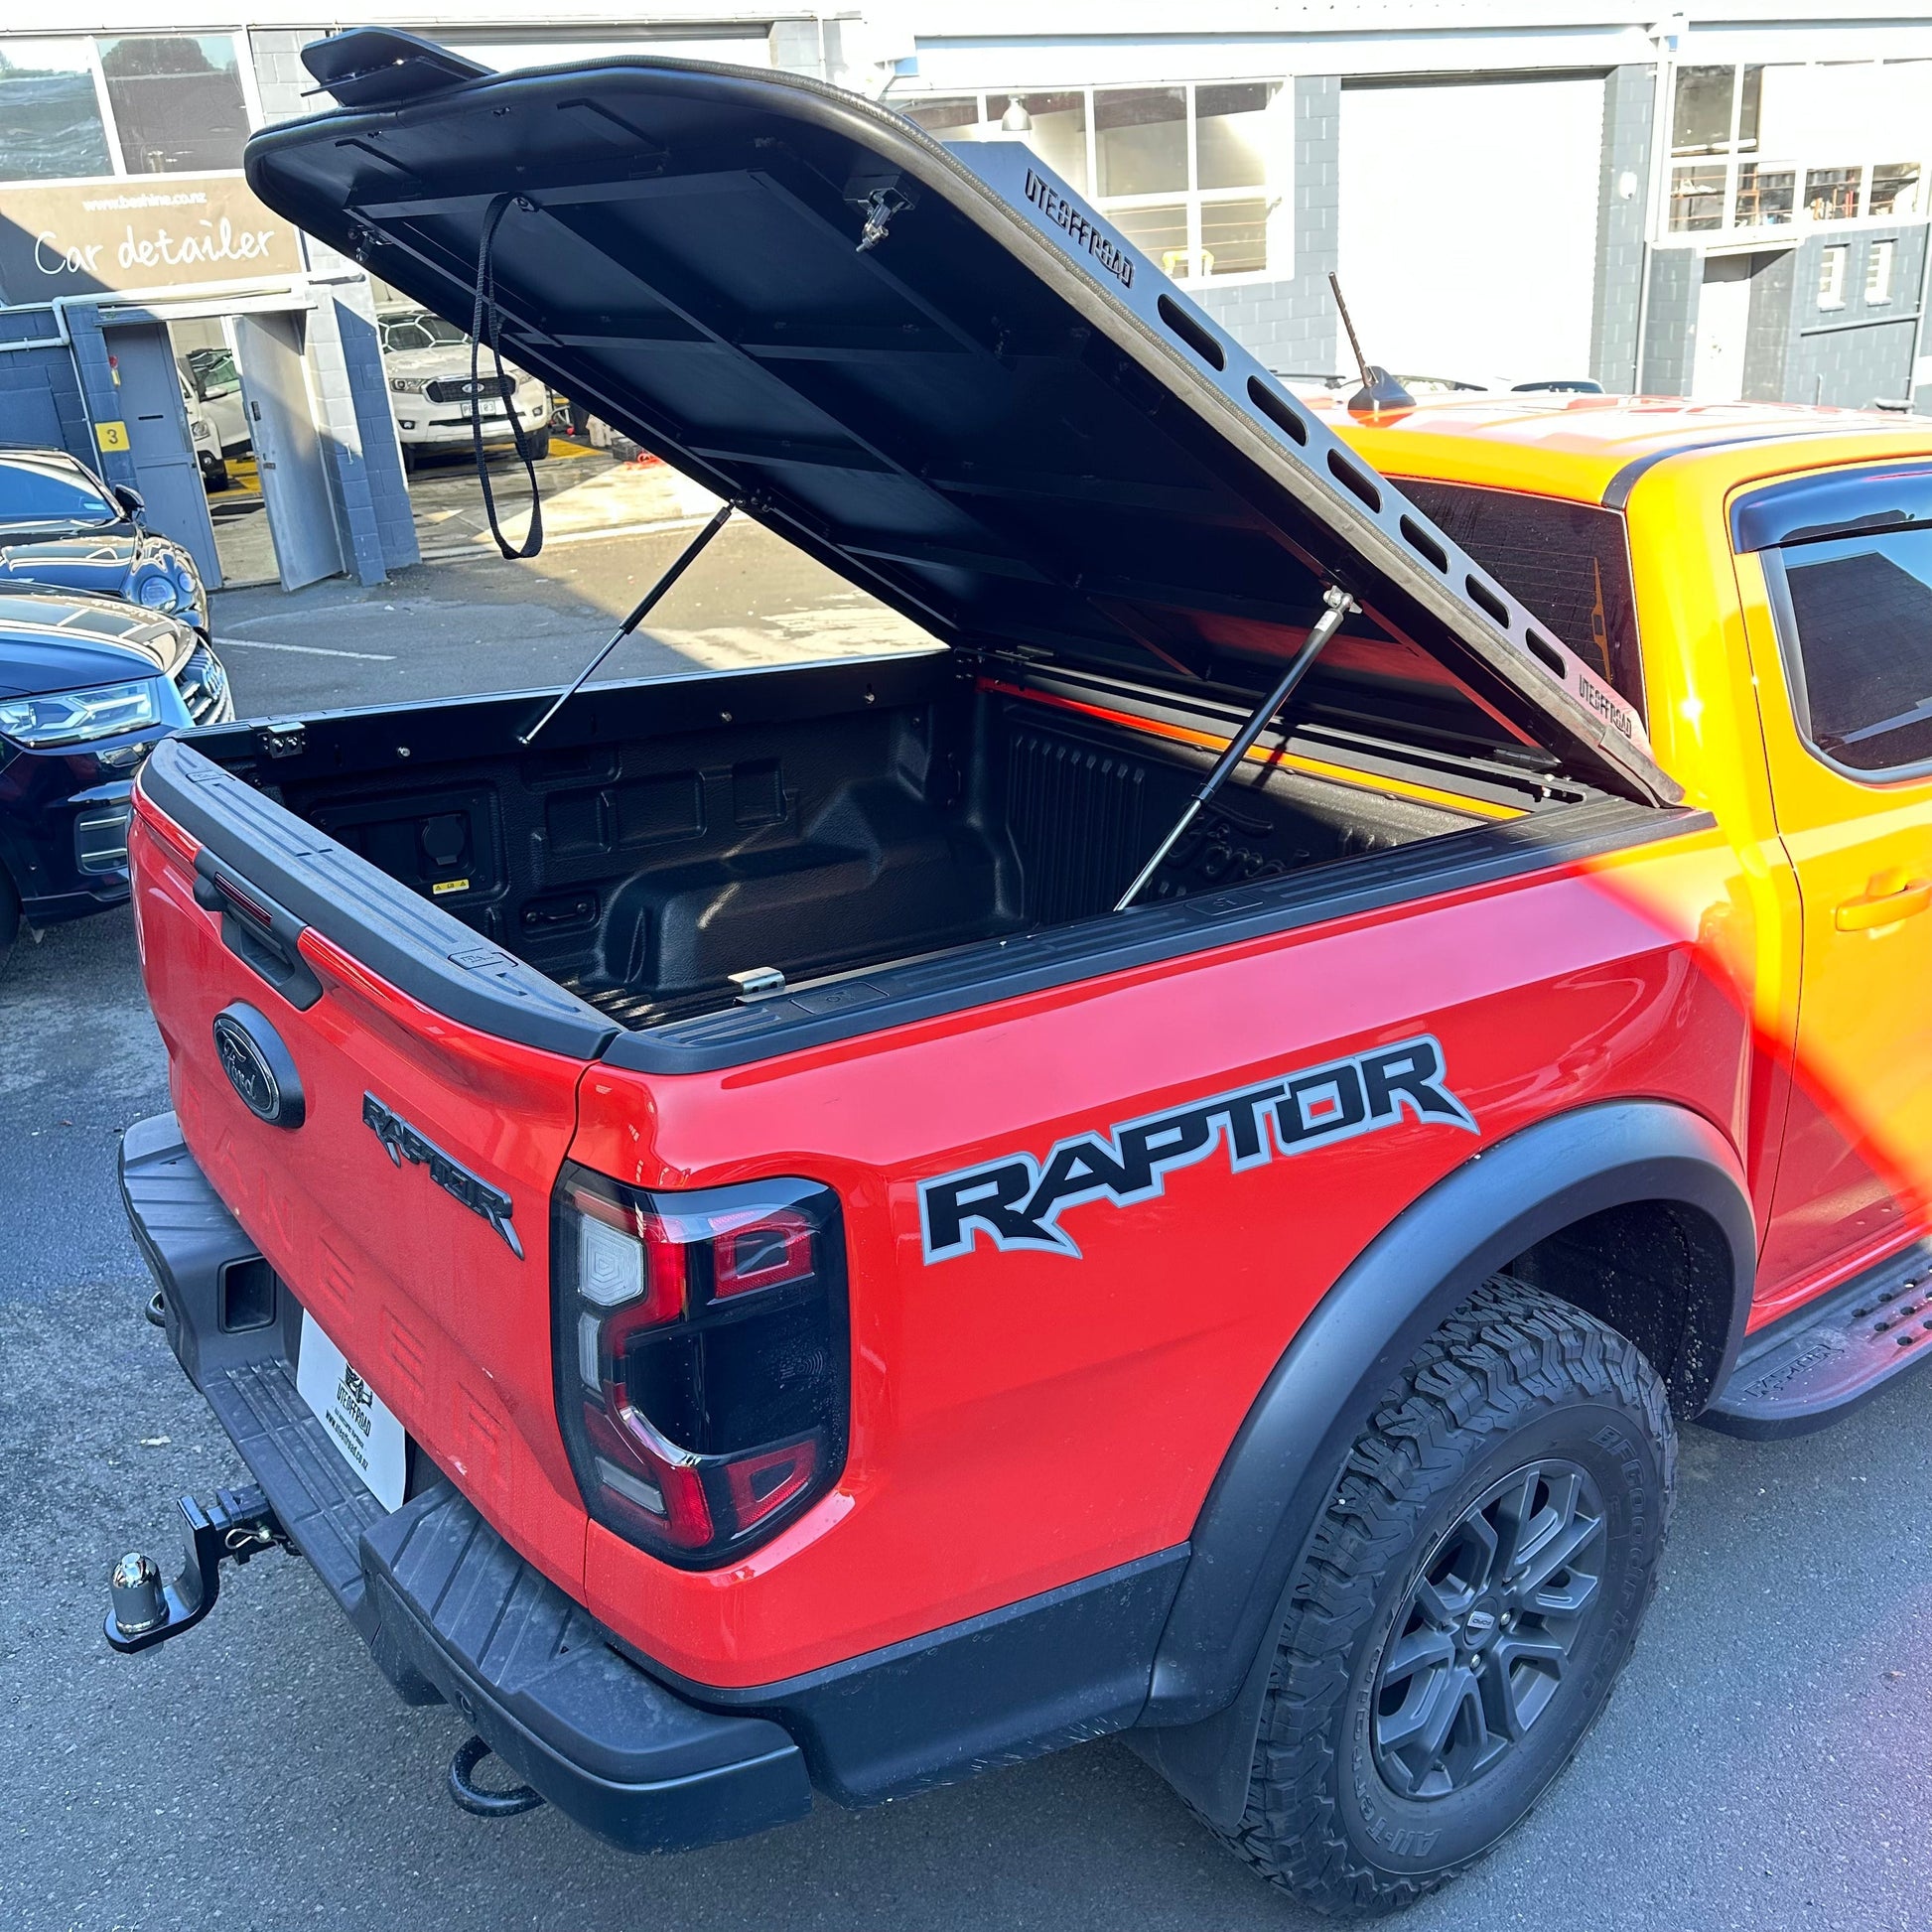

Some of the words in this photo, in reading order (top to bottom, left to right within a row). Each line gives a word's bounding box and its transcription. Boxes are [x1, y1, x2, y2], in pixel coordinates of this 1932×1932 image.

[34, 230, 103, 276] Car
[117, 215, 275, 270] detailer
[106, 428, 119, 445] 3
[221, 1036, 257, 1101] Ford
[362, 1089, 525, 1262] RAPTOR
[916, 1034, 1480, 1266] RAPTOR
